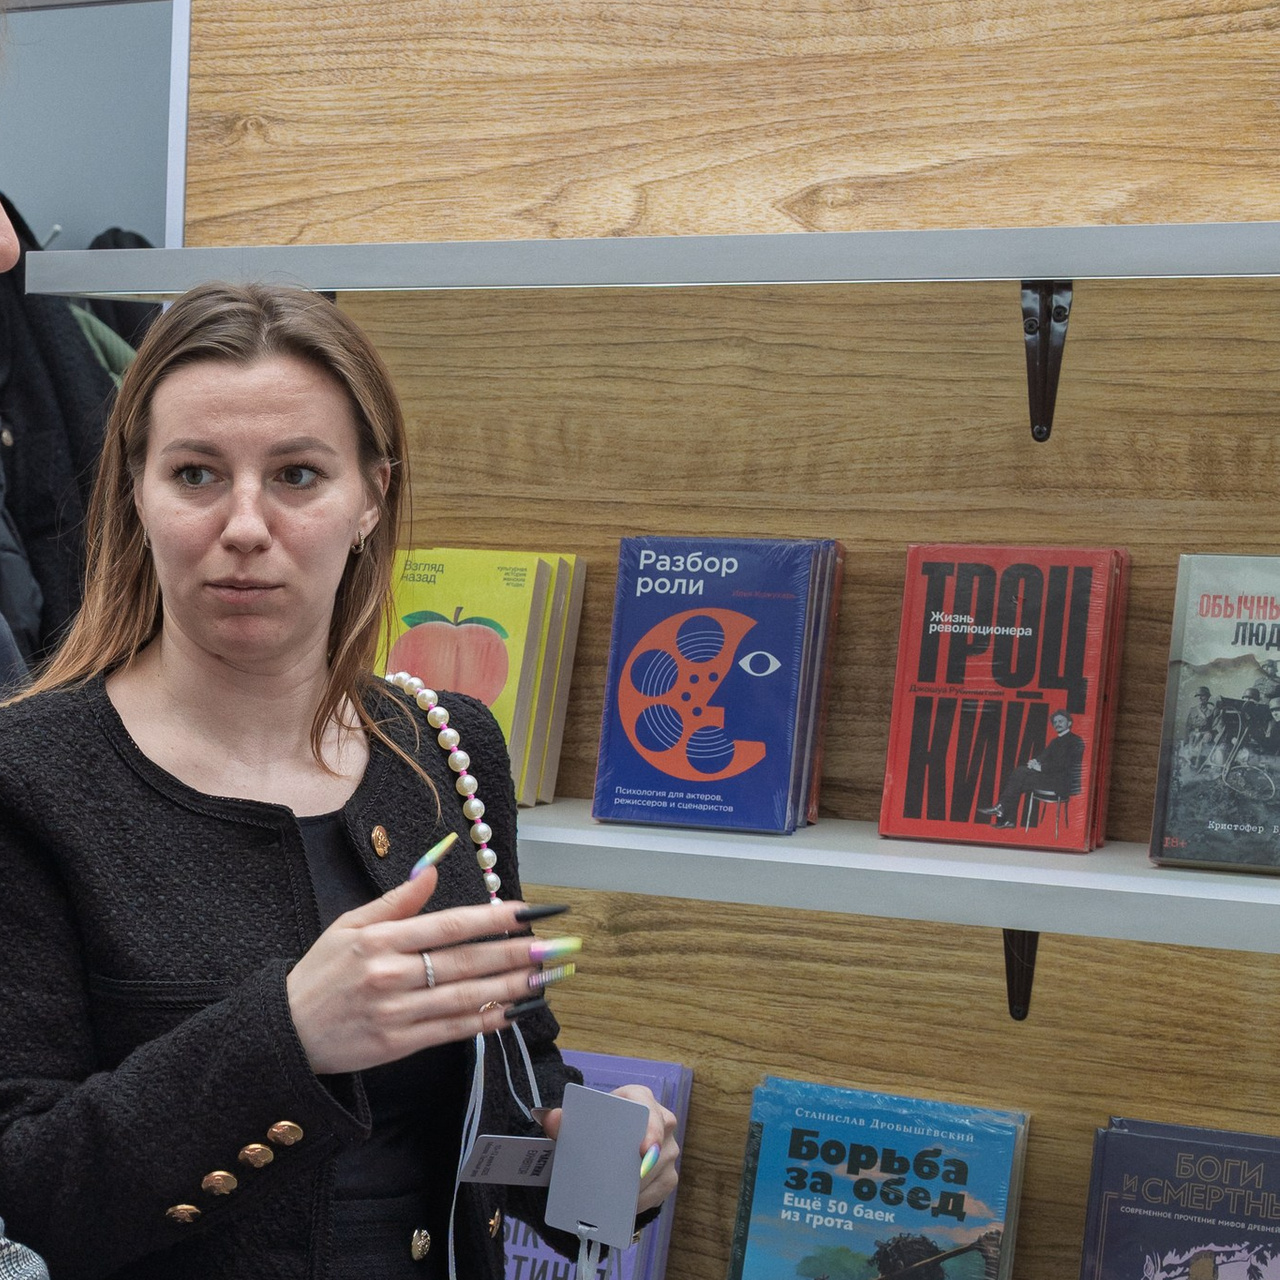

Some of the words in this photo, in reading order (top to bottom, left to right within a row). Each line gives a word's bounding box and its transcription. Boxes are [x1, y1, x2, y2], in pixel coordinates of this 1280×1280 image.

[404, 560, 445, 575] Взгляд
[638, 550, 739, 577] Разбор
[401, 573, 437, 585] назад
[635, 574, 705, 597] роли
[930, 610, 975, 624] Жизнь
[1199, 593, 1280, 620] ОБЫЧНЫ
[917, 562, 1093, 715] ТРОЦ
[928, 622, 1033, 638] революционера
[1231, 622, 1280, 651] ЛЮД
[614, 797, 667, 808] режиссеров
[677, 801, 734, 812] сценаристов
[615, 786, 667, 798] Психология
[668, 789, 684, 799] для
[685, 792, 723, 802] актеров,
[1208, 820, 1265, 834] Кристофер
[1163, 837, 1188, 848] 18+
[795, 1107, 866, 1128] СТАНИСЛАВ
[870, 1117, 975, 1143] ДРОБЫШЕВСКИЙ
[787, 1128, 970, 1186] Борьба
[1175, 1152, 1265, 1189] БОГИ
[783, 1166, 834, 1196] за
[853, 1176, 967, 1222] обед
[1122, 1173, 1139, 1193] И
[1141, 1177, 1280, 1221] СМЕРТН
[780, 1208, 801, 1223] из
[805, 1212, 854, 1232] грота
[782, 1191, 822, 1212] Ещё
[827, 1198, 848, 1216] 50
[853, 1199, 896, 1224] баек
[1120, 1205, 1172, 1220] СОВРЕМЕННОЕ
[1173, 1213, 1216, 1226] ПРОЧТЕНИЕ
[1218, 1219, 1246, 1230] МИФОВ
